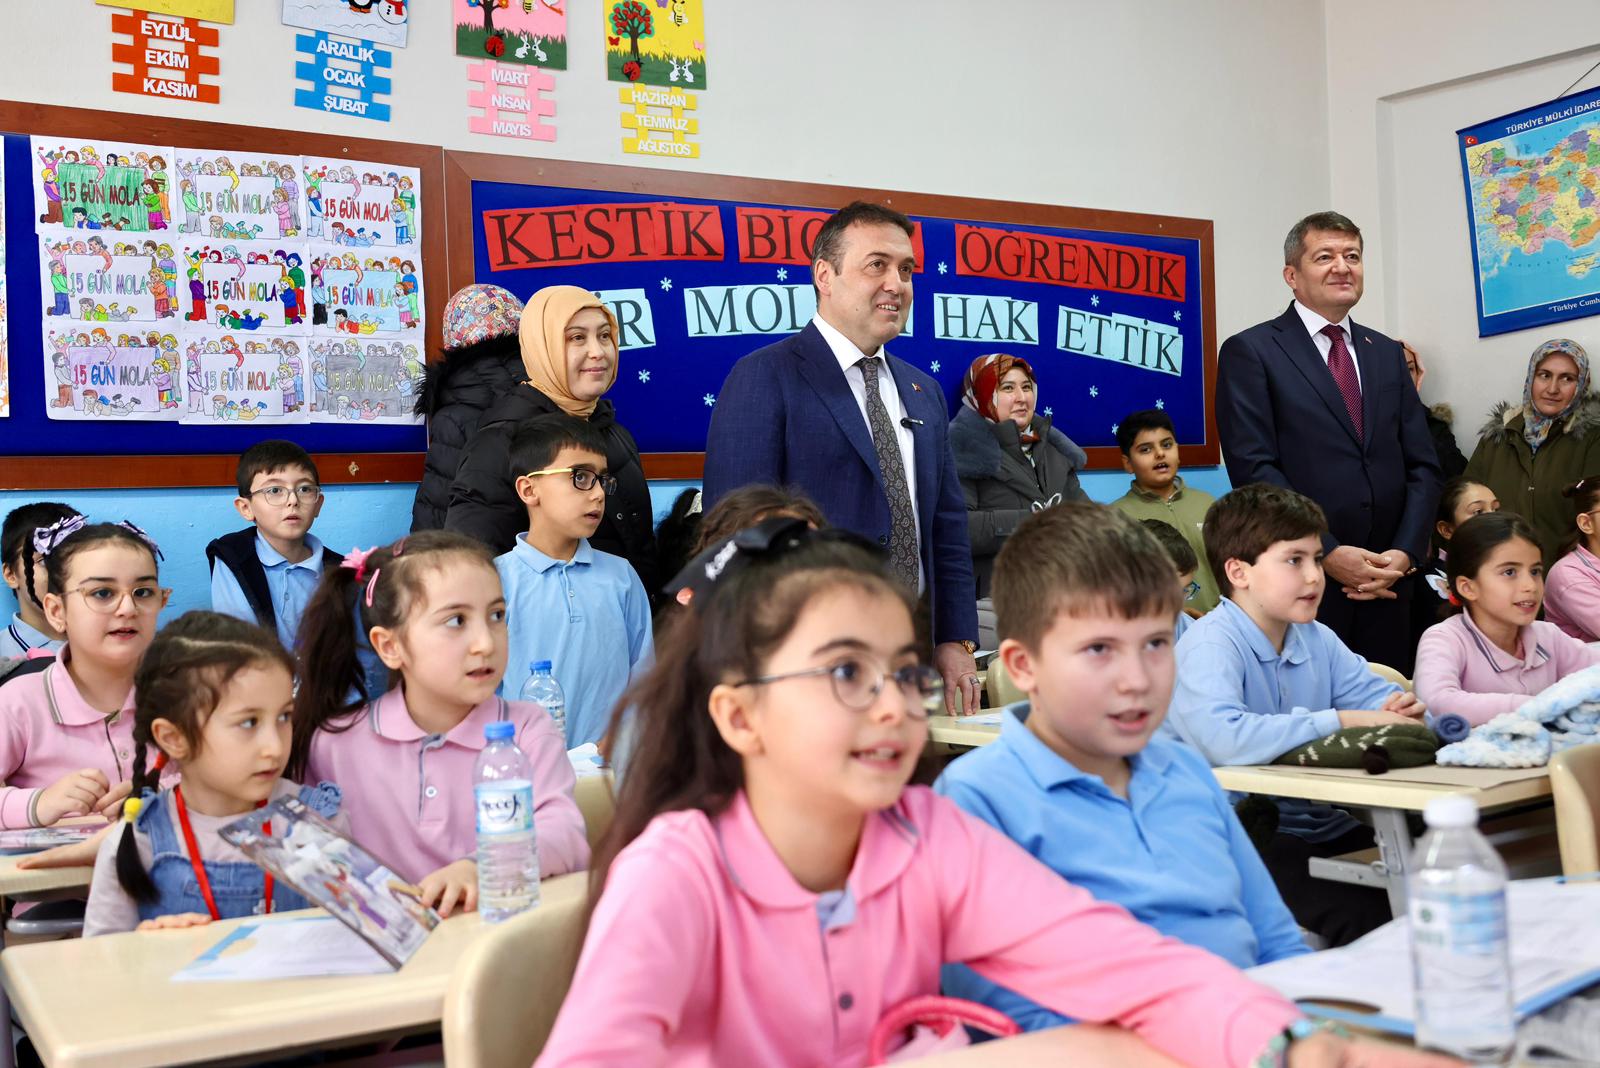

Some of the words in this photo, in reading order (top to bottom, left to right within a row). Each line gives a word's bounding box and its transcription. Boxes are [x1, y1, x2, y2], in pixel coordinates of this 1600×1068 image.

[140, 20, 195, 42] EYLÜL
[145, 49, 189, 69] EKİM
[316, 39, 375, 63] ARALIK
[143, 78, 197, 98] KASIM
[322, 68, 366, 88] OCAK
[491, 68, 530, 85] MART
[323, 95, 368, 115] ŞUBAT
[491, 93, 531, 112] NİSAN
[631, 90, 686, 107] HAZİRAN
[493, 120, 532, 137] MAYIS
[635, 114, 688, 131] TEMMUZ
[1506, 117, 1543, 134] TÜRKİYE
[1545, 107, 1573, 123] MÜLKİ
[63, 182, 77, 202] 15
[81, 180, 105, 204] GÜN
[110, 185, 140, 206] MOLA
[201, 192, 212, 212] 15
[216, 190, 239, 214] GÜN
[242, 194, 272, 215] MOLA
[324, 198, 336, 218] 15
[339, 197, 360, 220] GÜN
[363, 202, 390, 222] MOLA
[489, 203, 723, 266] KESTİK
[70, 272, 84, 294] 15
[87, 269, 113, 294] GÜN
[116, 274, 147, 296] MOLA
[207, 279, 219, 300] 15
[222, 277, 245, 301] GÜN
[250, 282, 278, 302] MOLA
[327, 285, 338, 305] 15
[342, 284, 363, 306] GÜN
[366, 288, 393, 308] MOLA
[689, 285, 912, 335] MOL
[937, 296, 1037, 343] HAK
[1061, 310, 1181, 374] ETTİK
[73, 364, 87, 386] 15
[91, 361, 116, 386] GÜN
[119, 365, 150, 387] MOLA
[205, 371, 217, 391] 15
[220, 367, 243, 391] GÜN
[247, 371, 277, 391] MOLA
